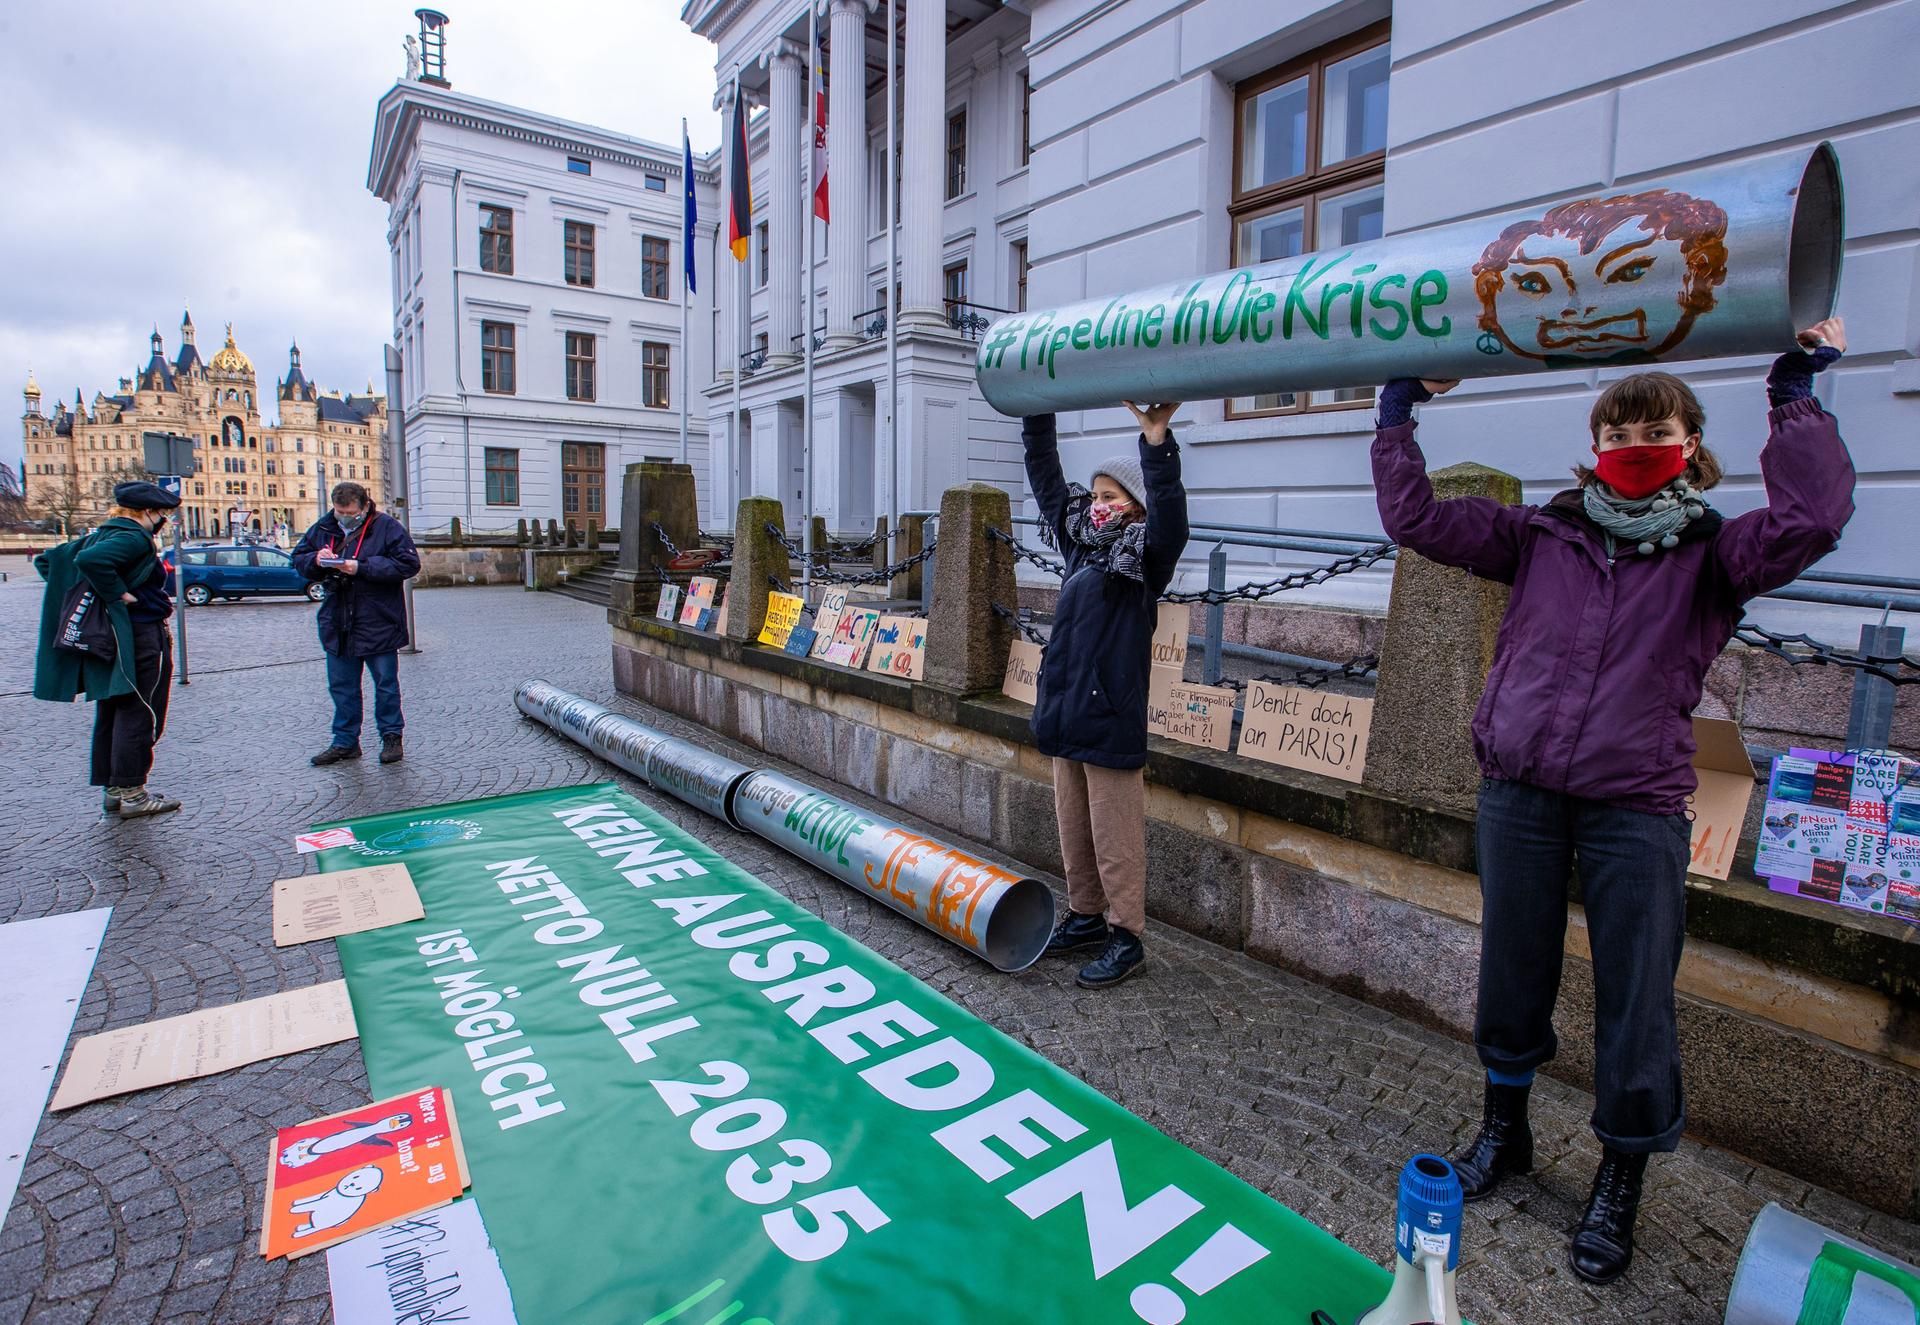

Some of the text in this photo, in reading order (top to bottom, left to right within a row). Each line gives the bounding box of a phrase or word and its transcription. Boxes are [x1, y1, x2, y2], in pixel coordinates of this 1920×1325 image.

[823, 593, 845, 611] ECO
[816, 614, 837, 629] NOT
[1168, 711, 1184, 719] aber
[1252, 686, 1353, 727] Denkt doch
[1244, 728, 1267, 747] an
[1856, 768, 1895, 779] DARE
[1857, 756, 1896, 768] HOW
[1856, 778, 1894, 790] YOU?
[1800, 815, 1836, 824] #Neu
[1844, 833, 1858, 862] YOU?
[1859, 834, 1873, 865] DARE
[1875, 837, 1887, 868] HOW
[416, 929, 566, 1130] IST MÖGLICH
[485, 856, 892, 1262] NETTO NULL 2035
[552, 803, 1271, 1325] KEINE AUSREDEN!
[419, 1091, 446, 1184] Where is my
[397, 1136, 420, 1175] home?
